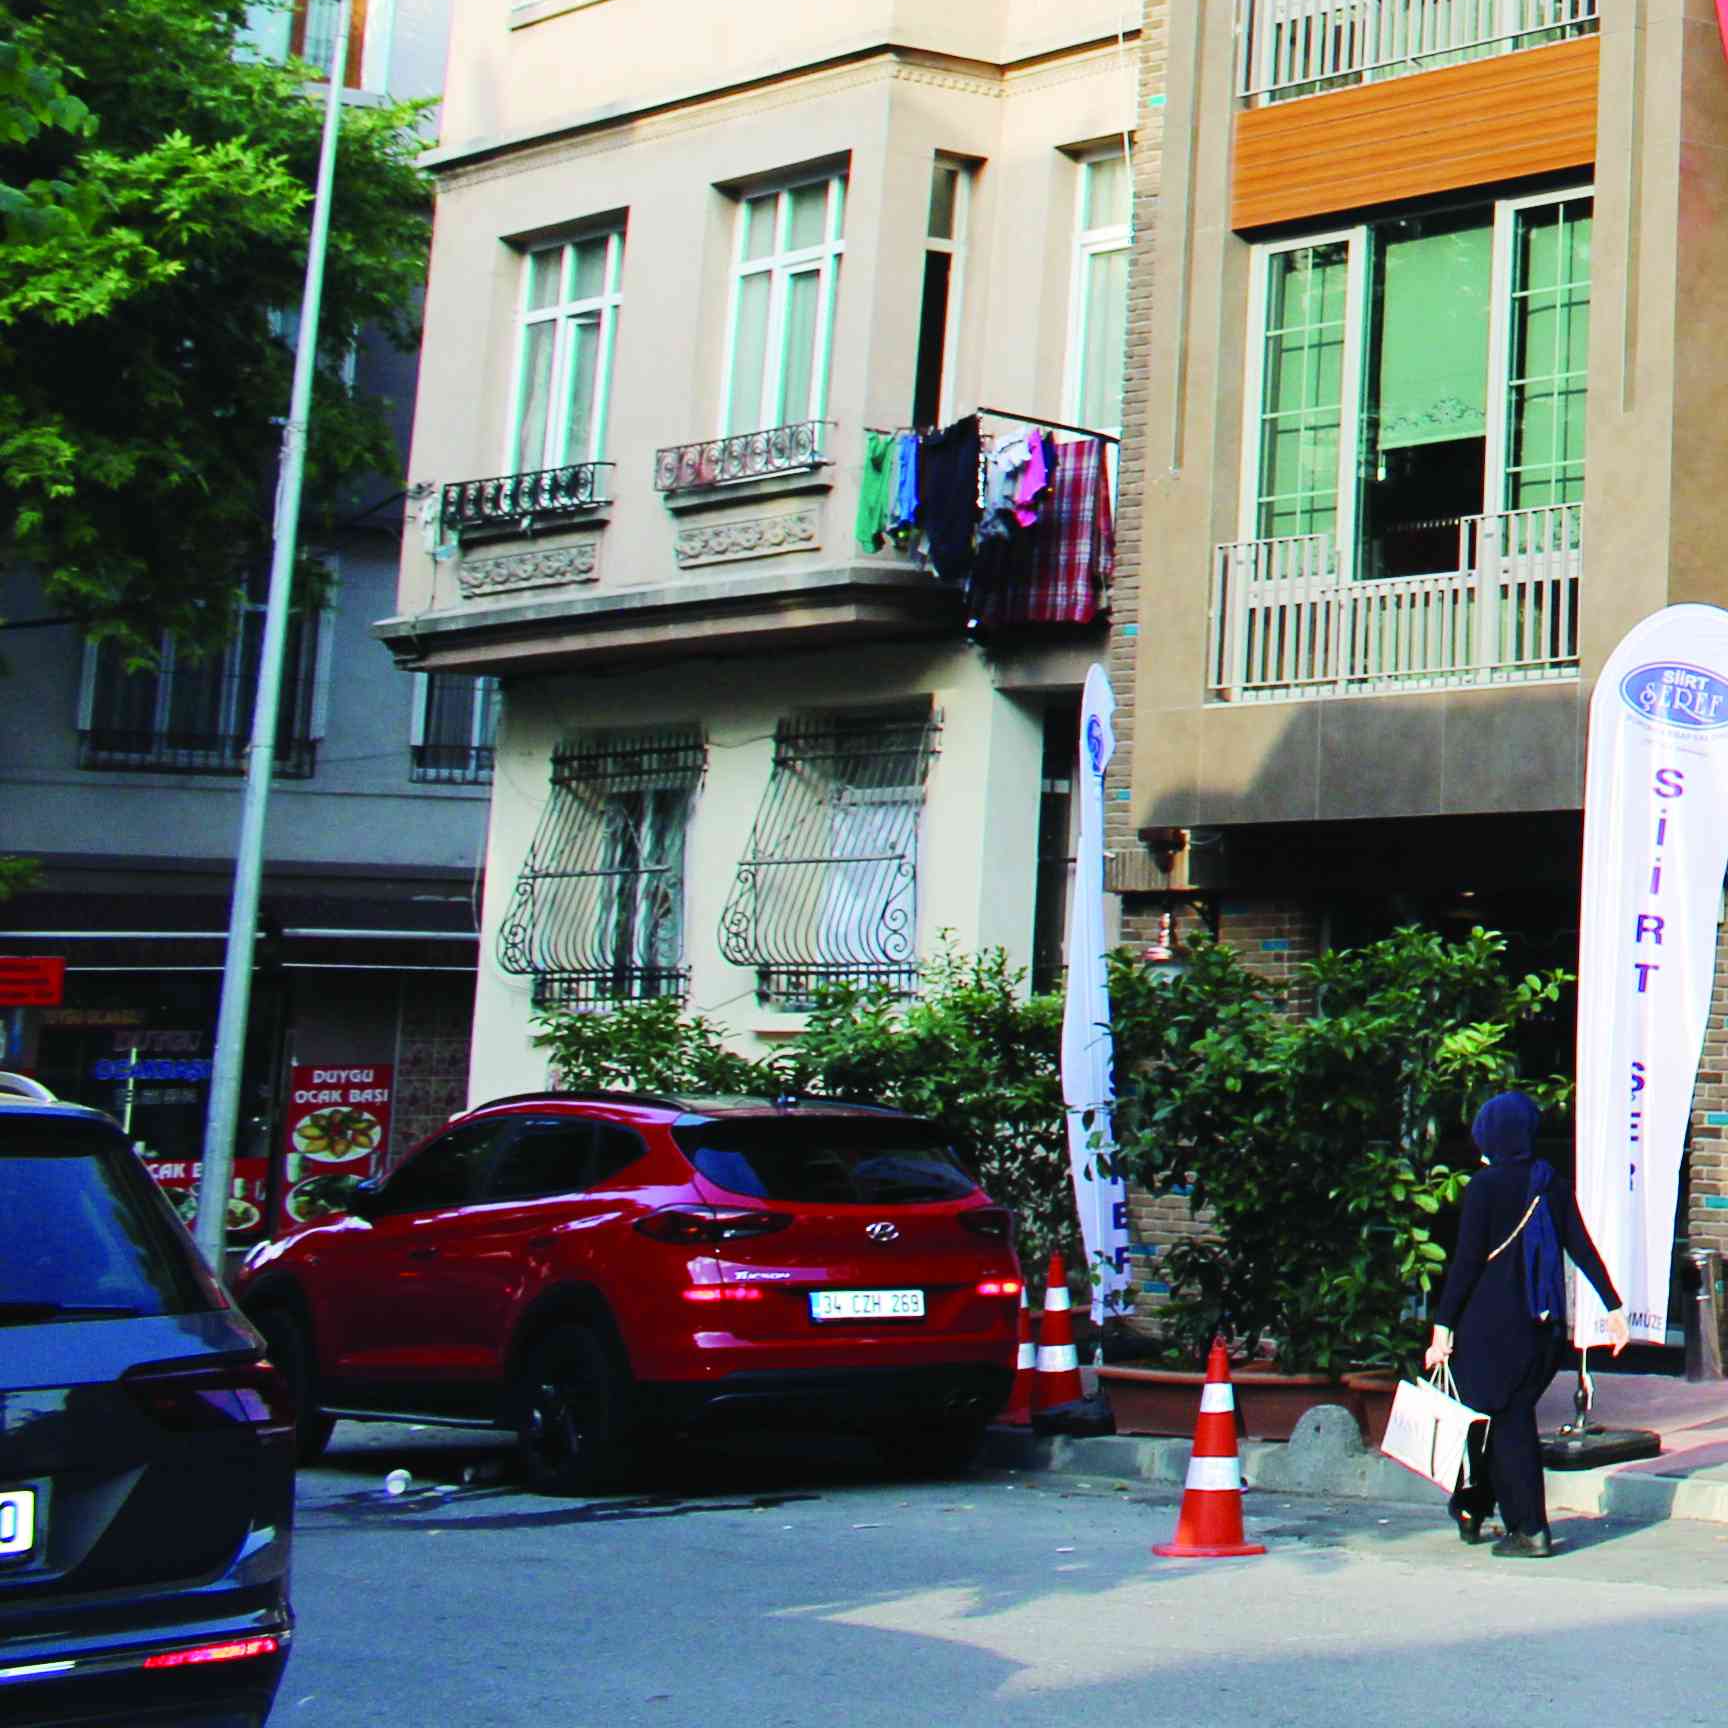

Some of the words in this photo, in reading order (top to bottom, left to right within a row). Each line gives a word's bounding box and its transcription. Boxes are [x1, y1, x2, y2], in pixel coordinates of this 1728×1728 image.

[313, 1070, 373, 1084] DUYGU
[295, 1089, 343, 1103] OCAK
[348, 1089, 389, 1106] BAŞI
[148, 1163, 184, 1179] CAK
[824, 1295, 841, 1314] 34
[852, 1295, 881, 1313] CZH
